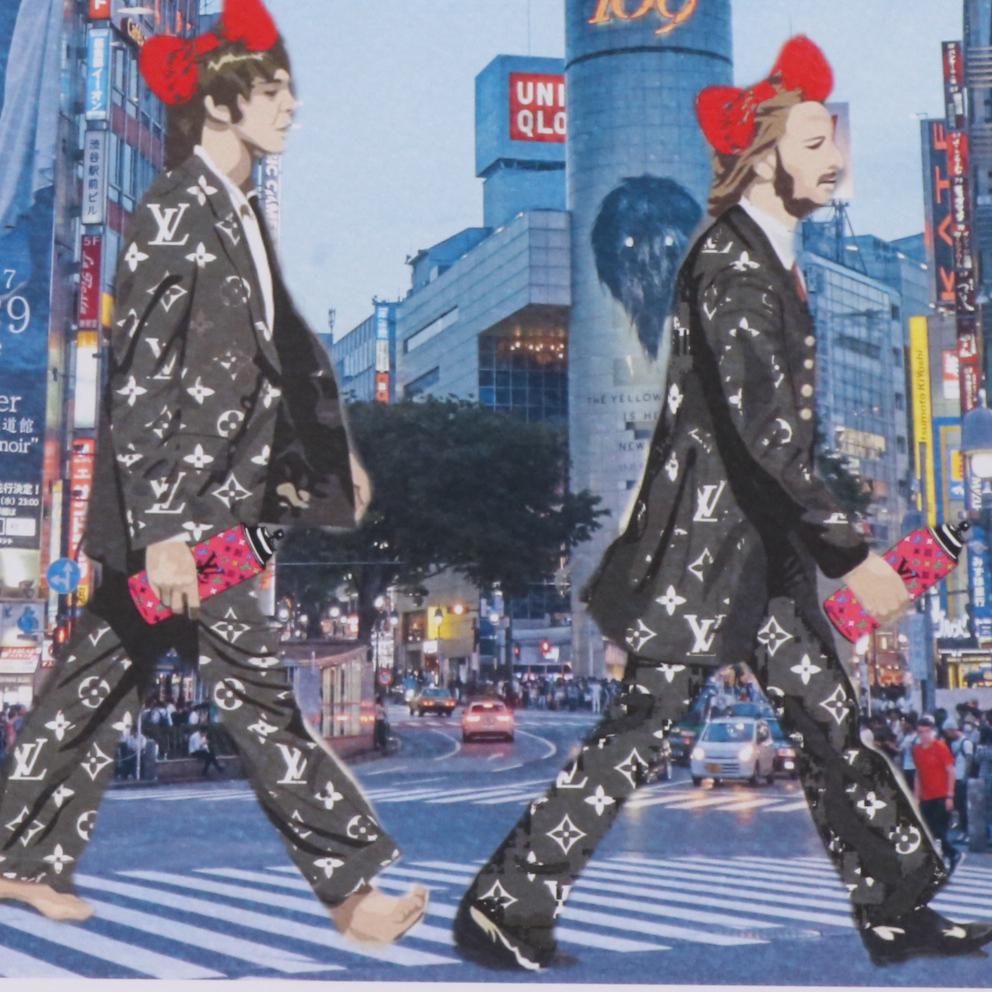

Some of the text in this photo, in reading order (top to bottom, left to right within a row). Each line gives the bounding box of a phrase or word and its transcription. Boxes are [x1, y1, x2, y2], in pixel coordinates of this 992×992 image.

[516, 81, 566, 107] UNI
[516, 109, 568, 137] QLO
[611, 392, 664, 404] YELLOW
